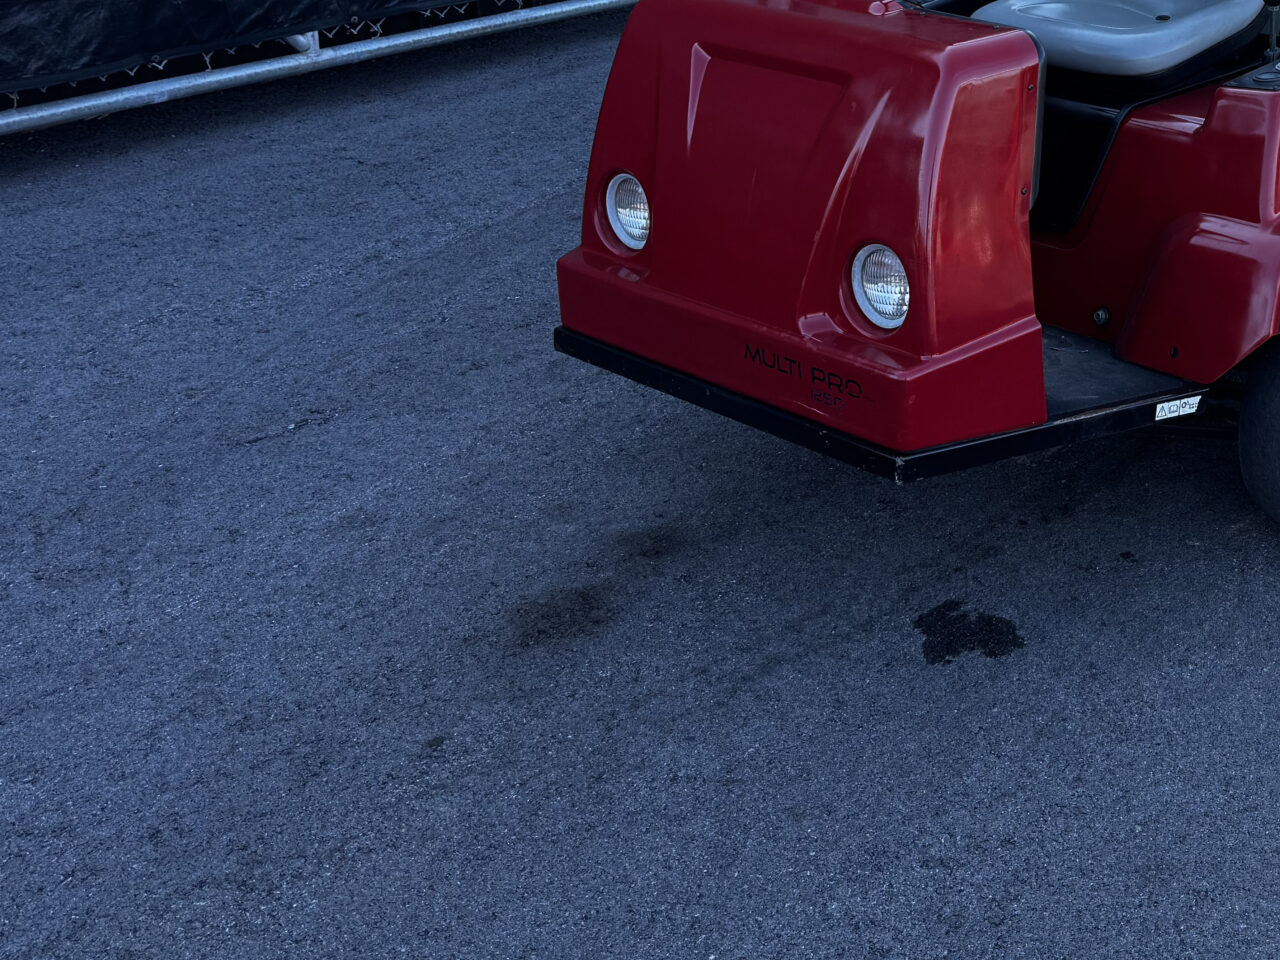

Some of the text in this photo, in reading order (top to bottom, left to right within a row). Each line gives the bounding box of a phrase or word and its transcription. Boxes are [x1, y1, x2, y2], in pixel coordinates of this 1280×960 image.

[744, 343, 863, 399] MULTI PRO
[811, 389, 845, 410] 1250
